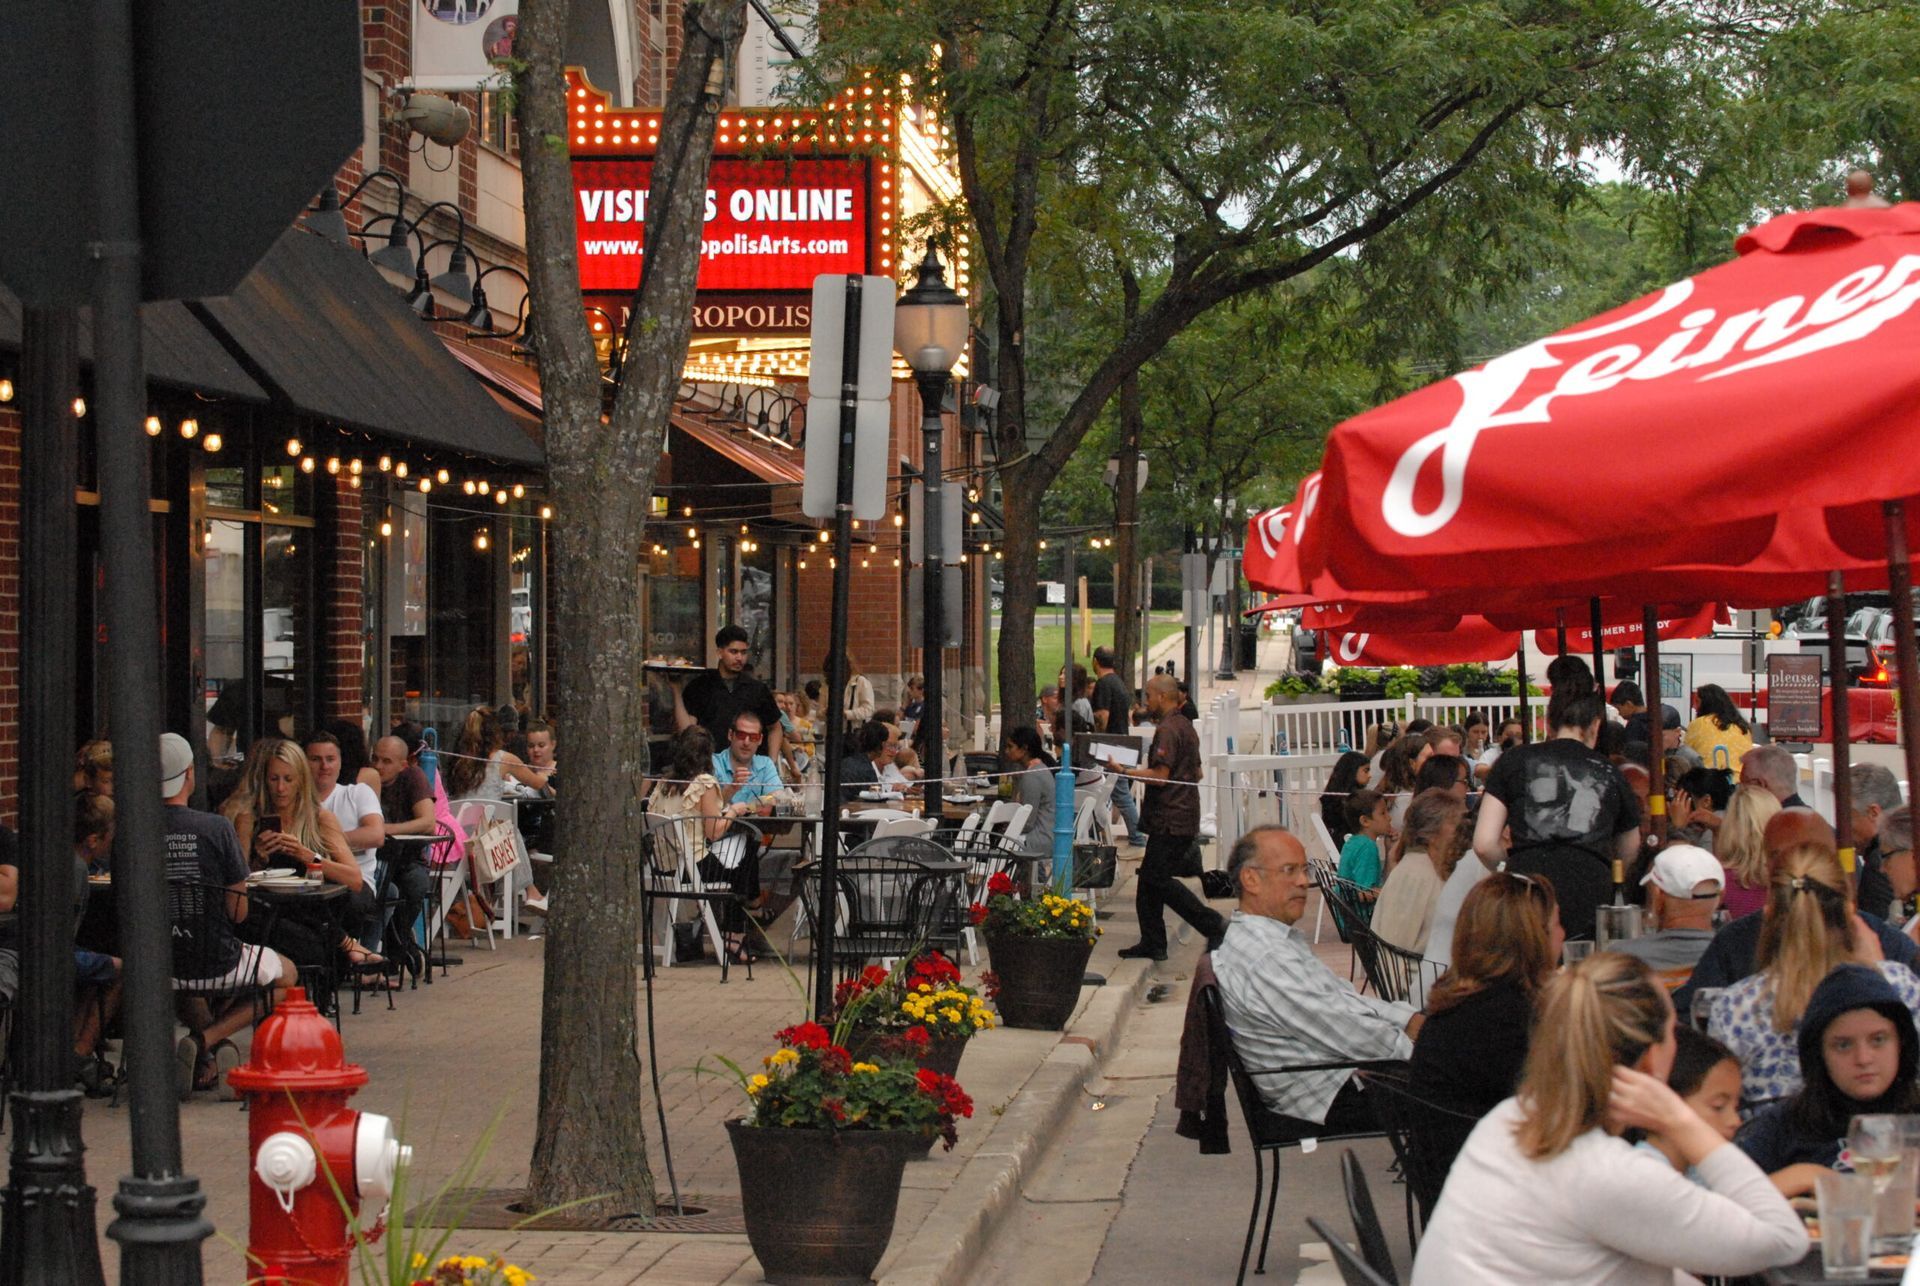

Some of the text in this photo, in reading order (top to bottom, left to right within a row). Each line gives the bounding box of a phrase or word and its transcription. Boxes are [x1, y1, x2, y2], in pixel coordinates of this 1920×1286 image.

[730, 189, 852, 221] ONLINE
[584, 234, 848, 259] www.opolisArts.com
[620, 305, 810, 328] ROPOLIS
[1581, 620, 1671, 639] SMER SHDY
[1771, 669, 1818, 688] please.
[168, 841, 198, 851] things
[178, 850, 198, 858] time.
